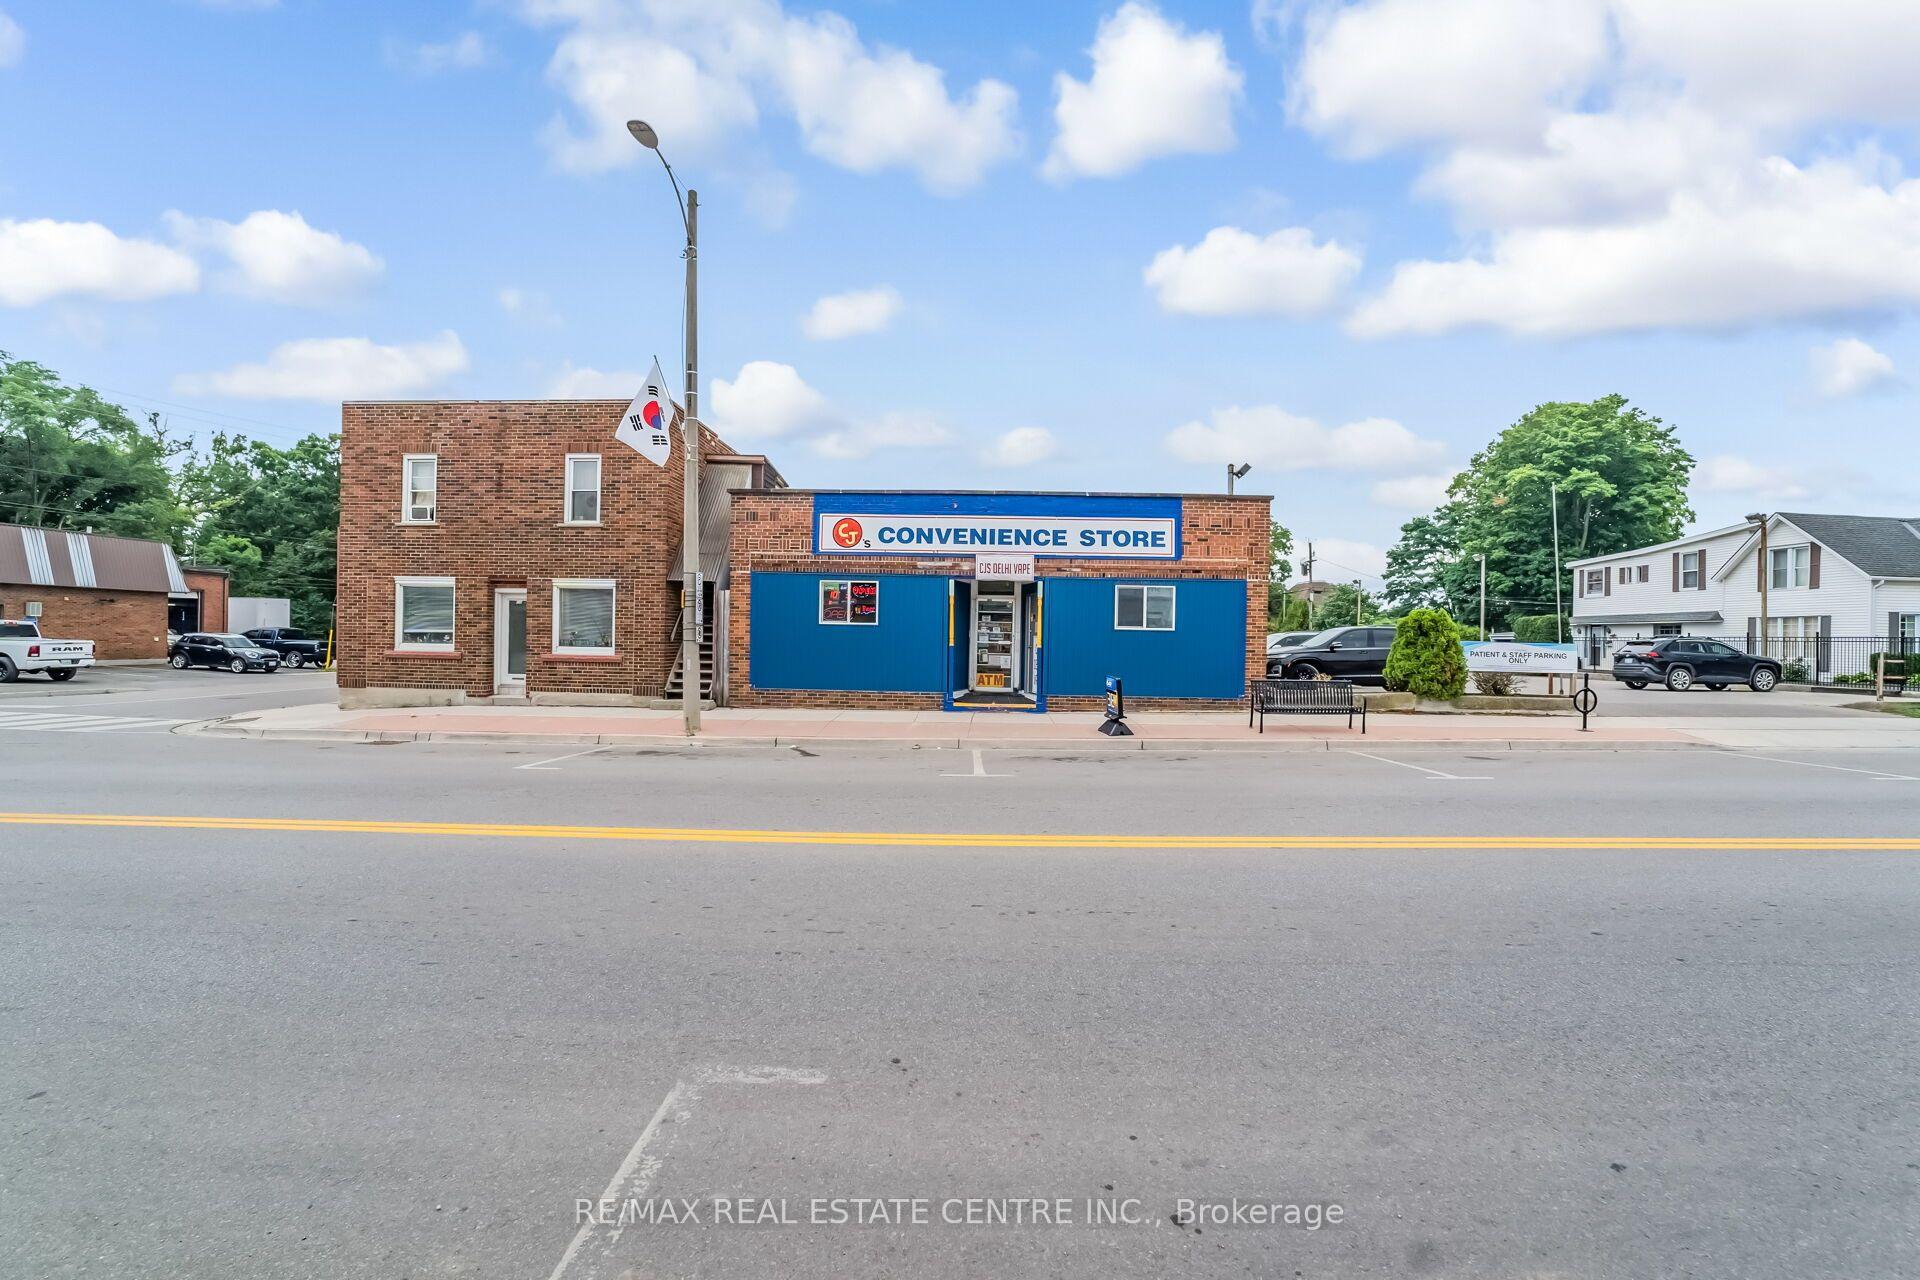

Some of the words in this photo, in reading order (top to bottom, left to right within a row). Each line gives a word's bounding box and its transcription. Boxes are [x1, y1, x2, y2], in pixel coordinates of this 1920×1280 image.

[878, 526, 1067, 547] CONVENIENCE
[1079, 529, 1166, 548] STORE
[979, 563, 991, 574] CJS
[993, 563, 1012, 574] DELHI
[1014, 564, 1031, 574] VAPE
[977, 674, 1004, 686] ATM
